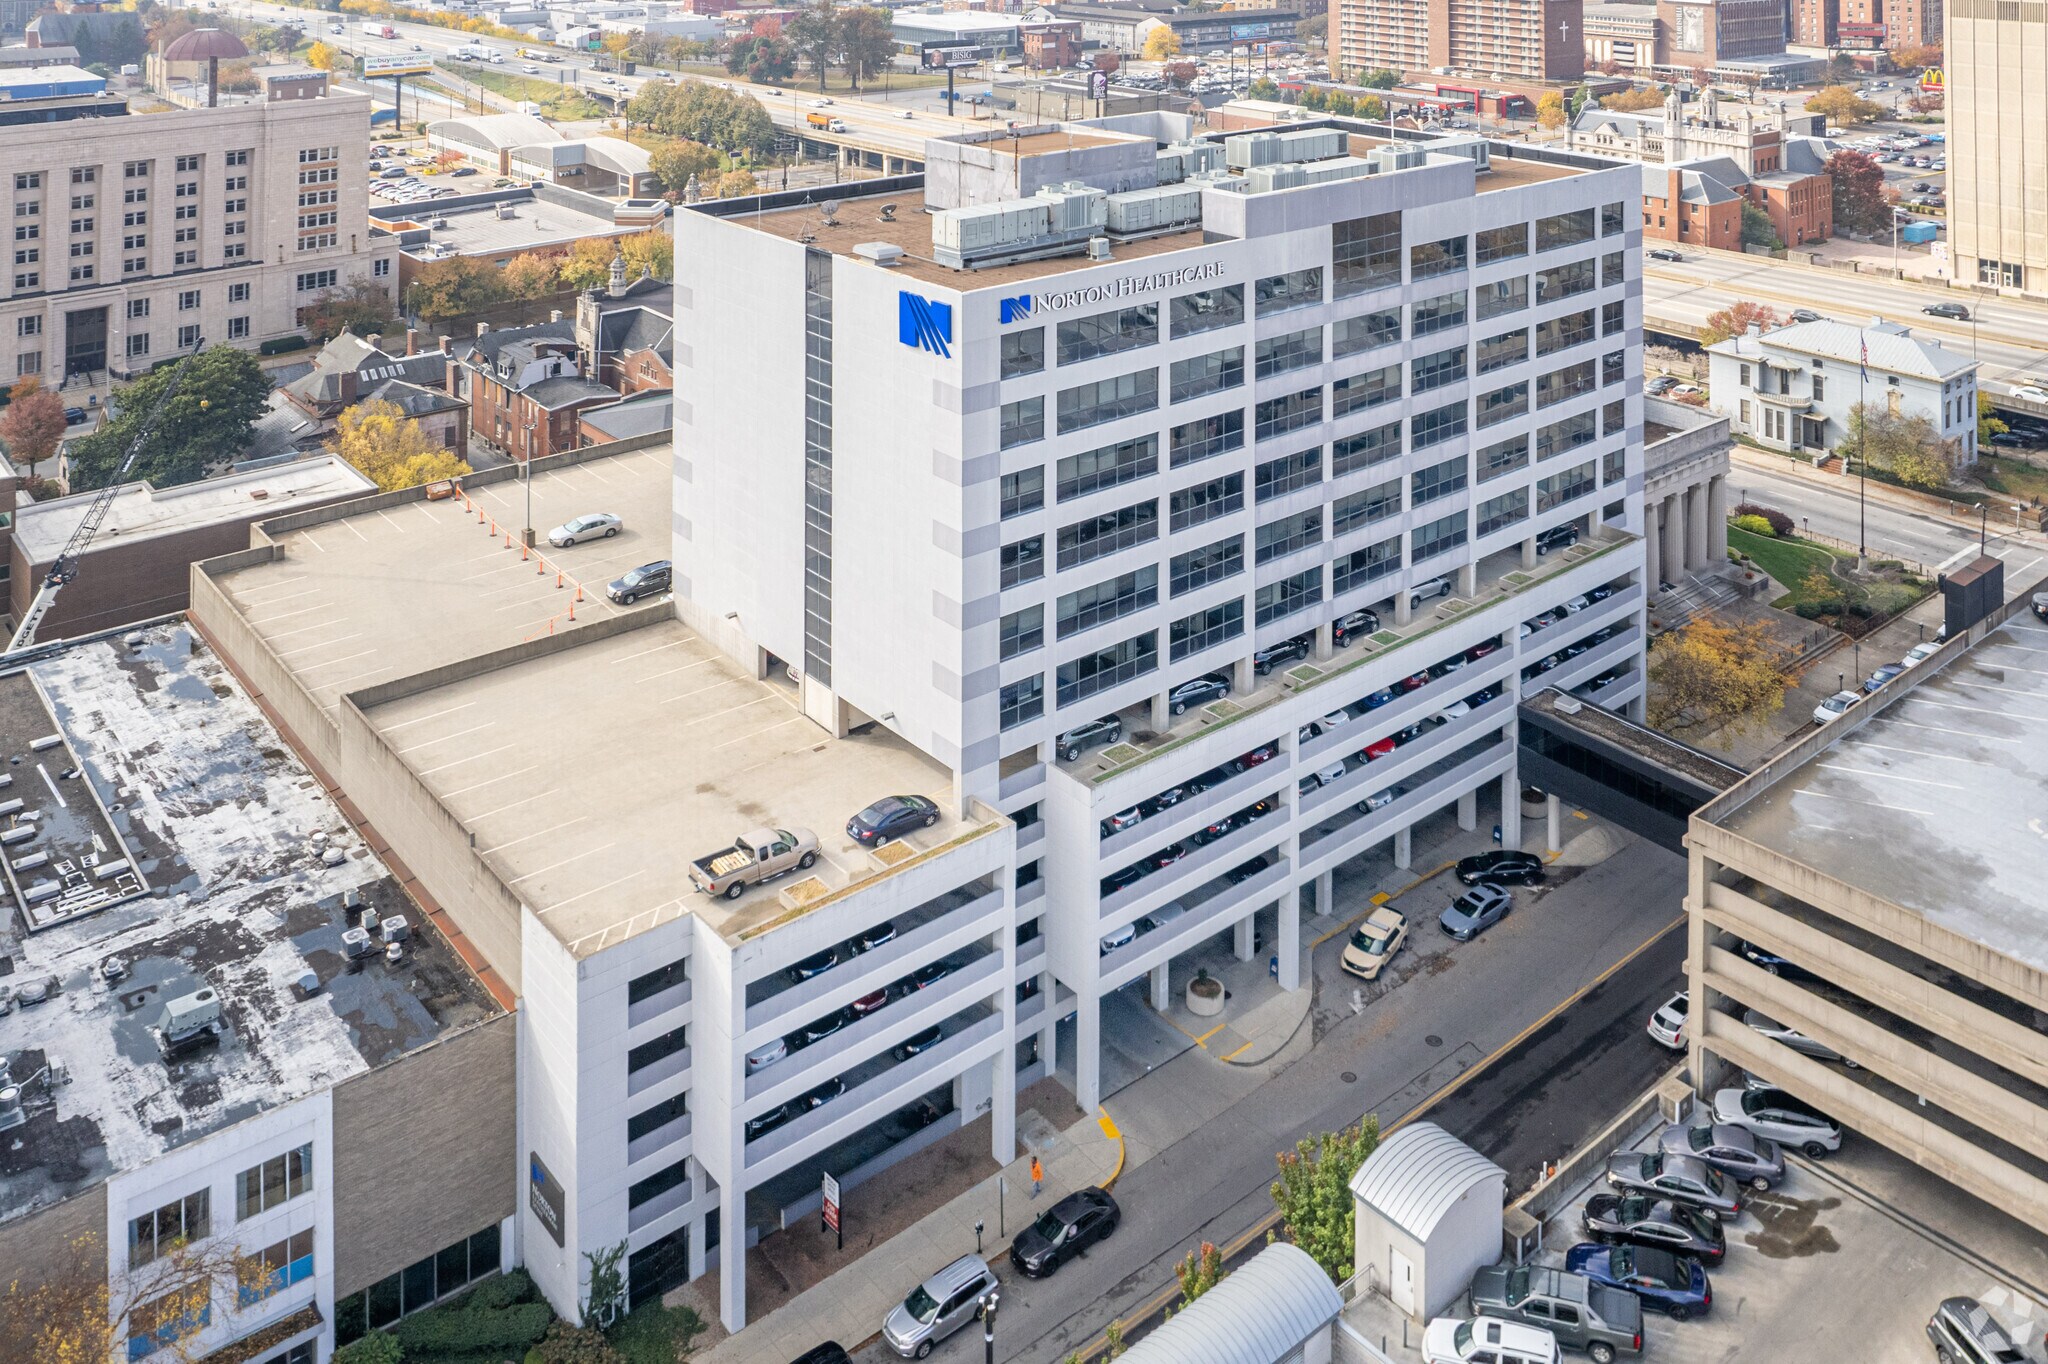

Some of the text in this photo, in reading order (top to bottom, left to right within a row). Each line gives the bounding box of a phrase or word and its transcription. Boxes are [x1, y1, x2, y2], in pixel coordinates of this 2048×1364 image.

[367, 54, 431, 64] webuyanycar.com
[952, 51, 972, 60] BISIG
[1035, 261, 1225, 315] NORTON HEALTHCARE
